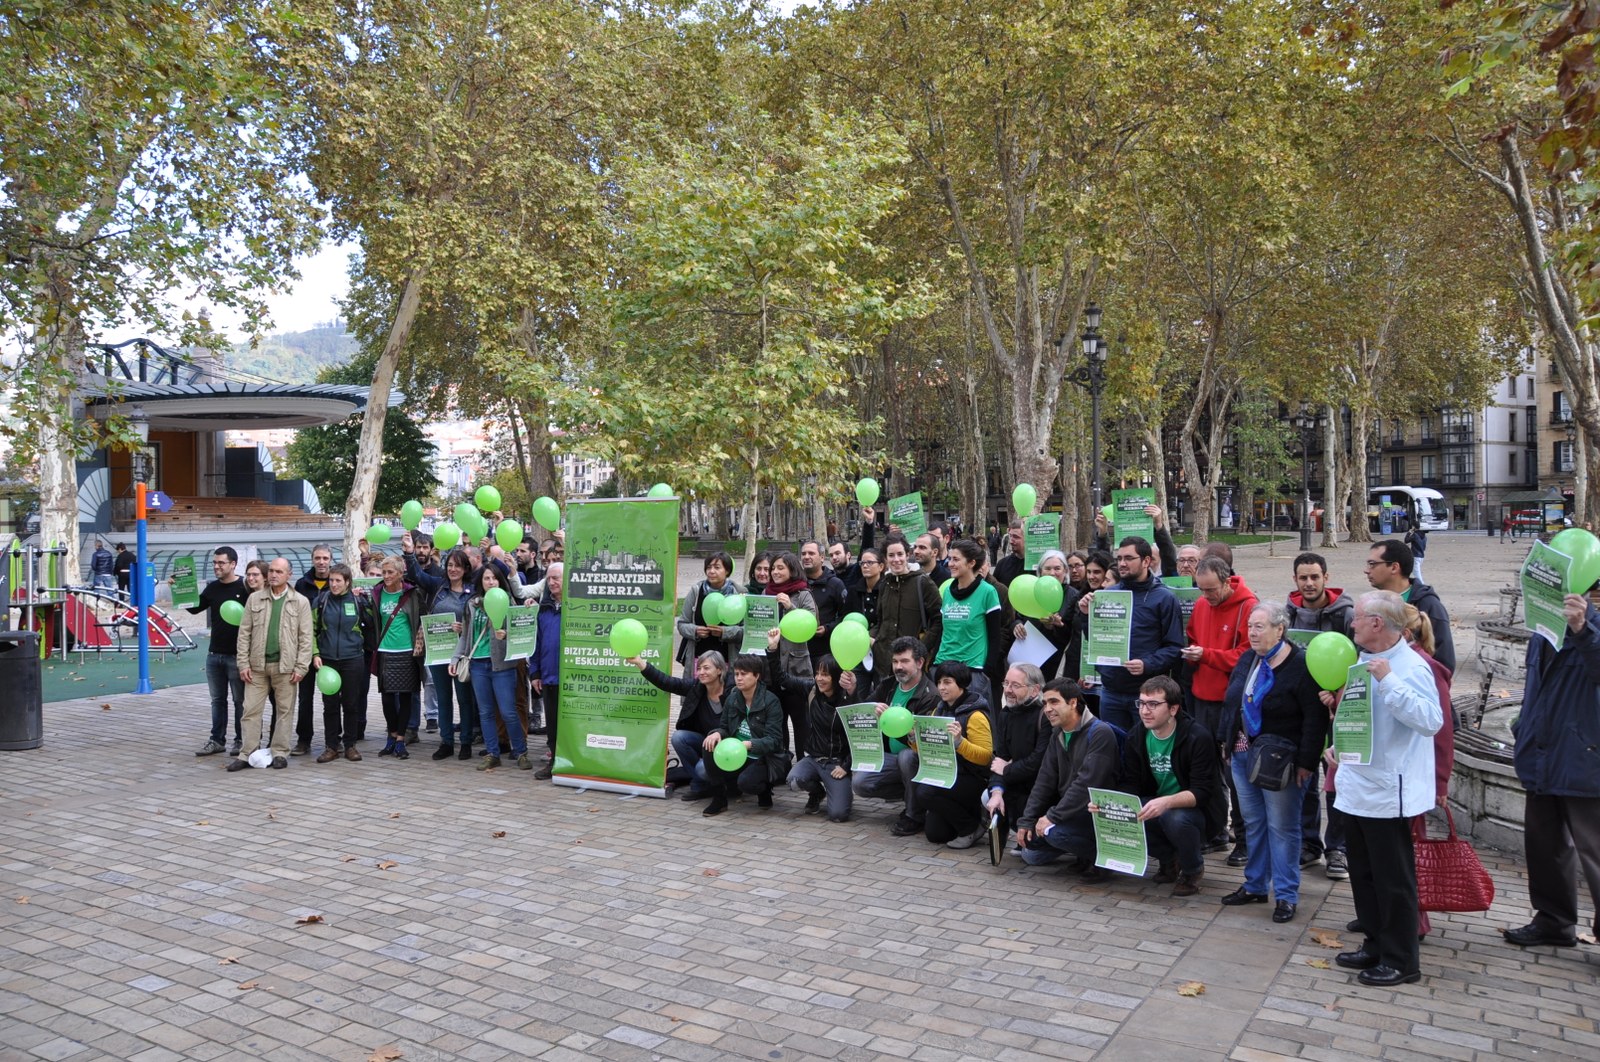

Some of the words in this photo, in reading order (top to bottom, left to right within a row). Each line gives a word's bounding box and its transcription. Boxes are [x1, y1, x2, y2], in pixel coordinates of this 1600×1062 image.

[570, 572, 660, 584] ALTERNATIBEN
[587, 586, 644, 596] HERRIA
[589, 604, 640, 614] BILBO
[564, 647, 600, 656] BIZITZA
[575, 658, 620, 666] ESKUBIDE
[571, 673, 594, 682] VIDA
[598, 675, 650, 686] SOBERANA
[578, 684, 610, 694] PLENO
[613, 687, 658, 697] DERECHO
[562, 701, 658, 714] #ALTERNATIBENHERRIA
